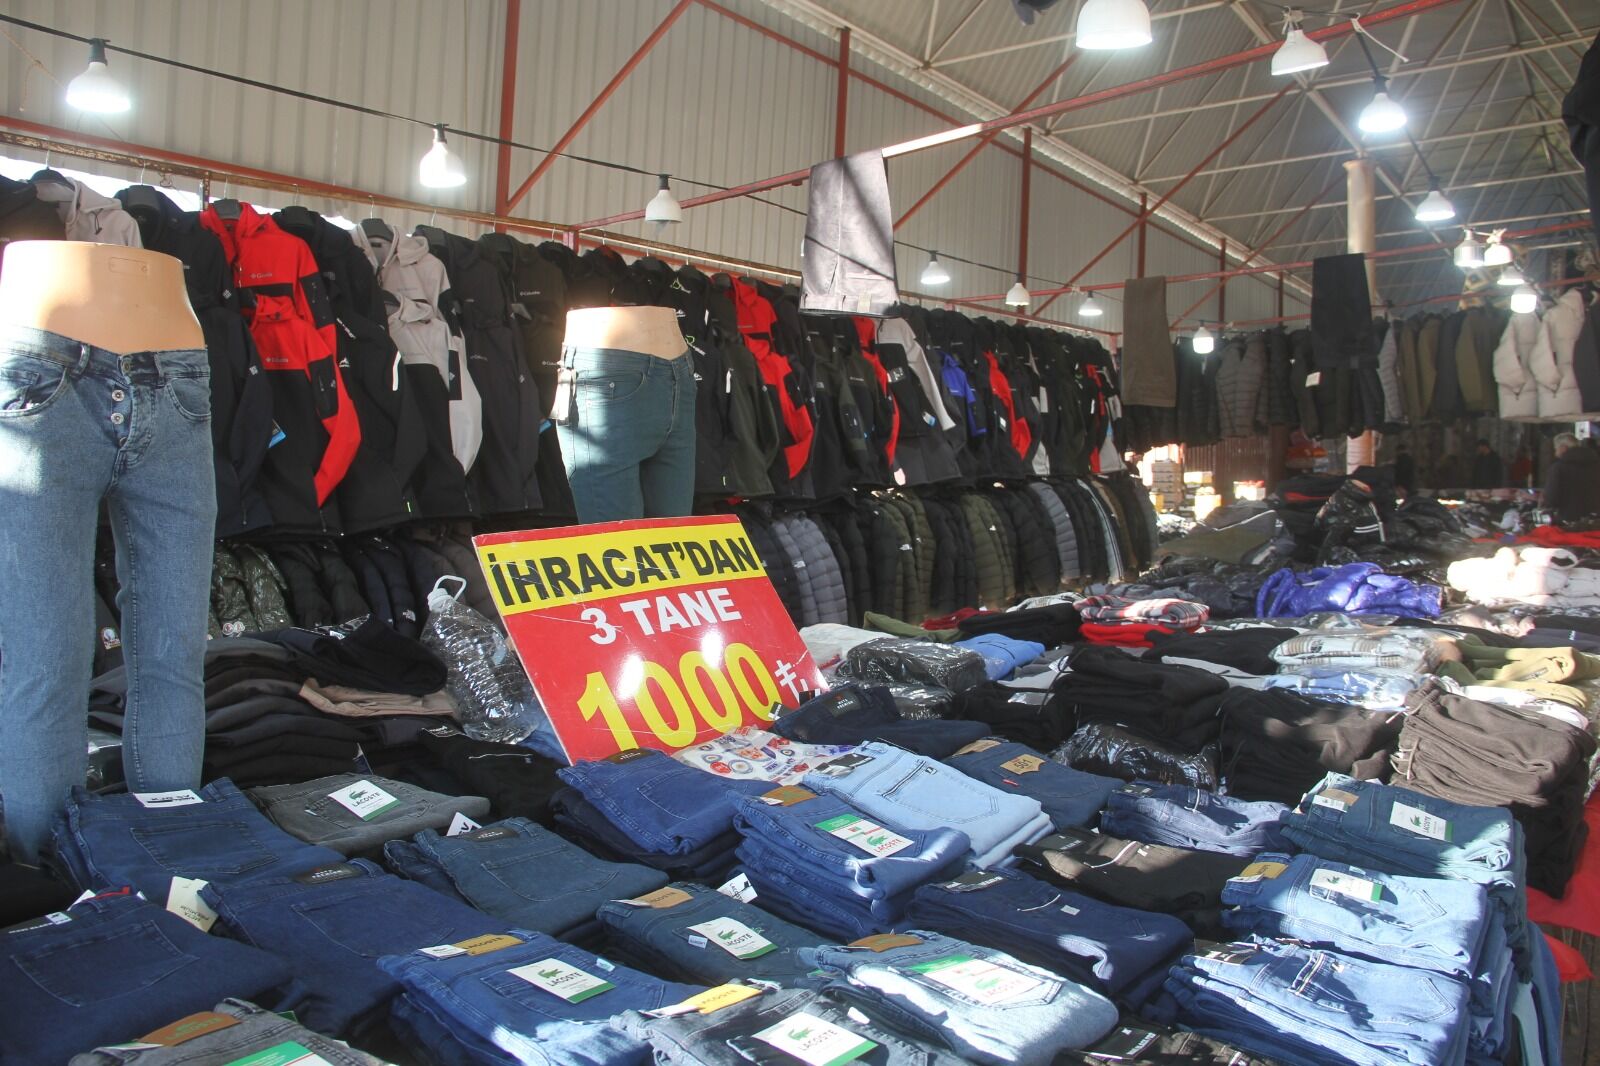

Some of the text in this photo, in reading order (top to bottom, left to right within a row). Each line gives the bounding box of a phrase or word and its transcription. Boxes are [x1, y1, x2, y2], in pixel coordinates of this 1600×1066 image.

[487, 536, 759, 607] İHRACAT'DAN
[580, 587, 742, 645] 3 TANE
[576, 642, 783, 753] 1000
[351, 791, 381, 807] LACOSTE
[724, 932, 753, 947] LACOSTE
[545, 971, 583, 987] LACOSTE
